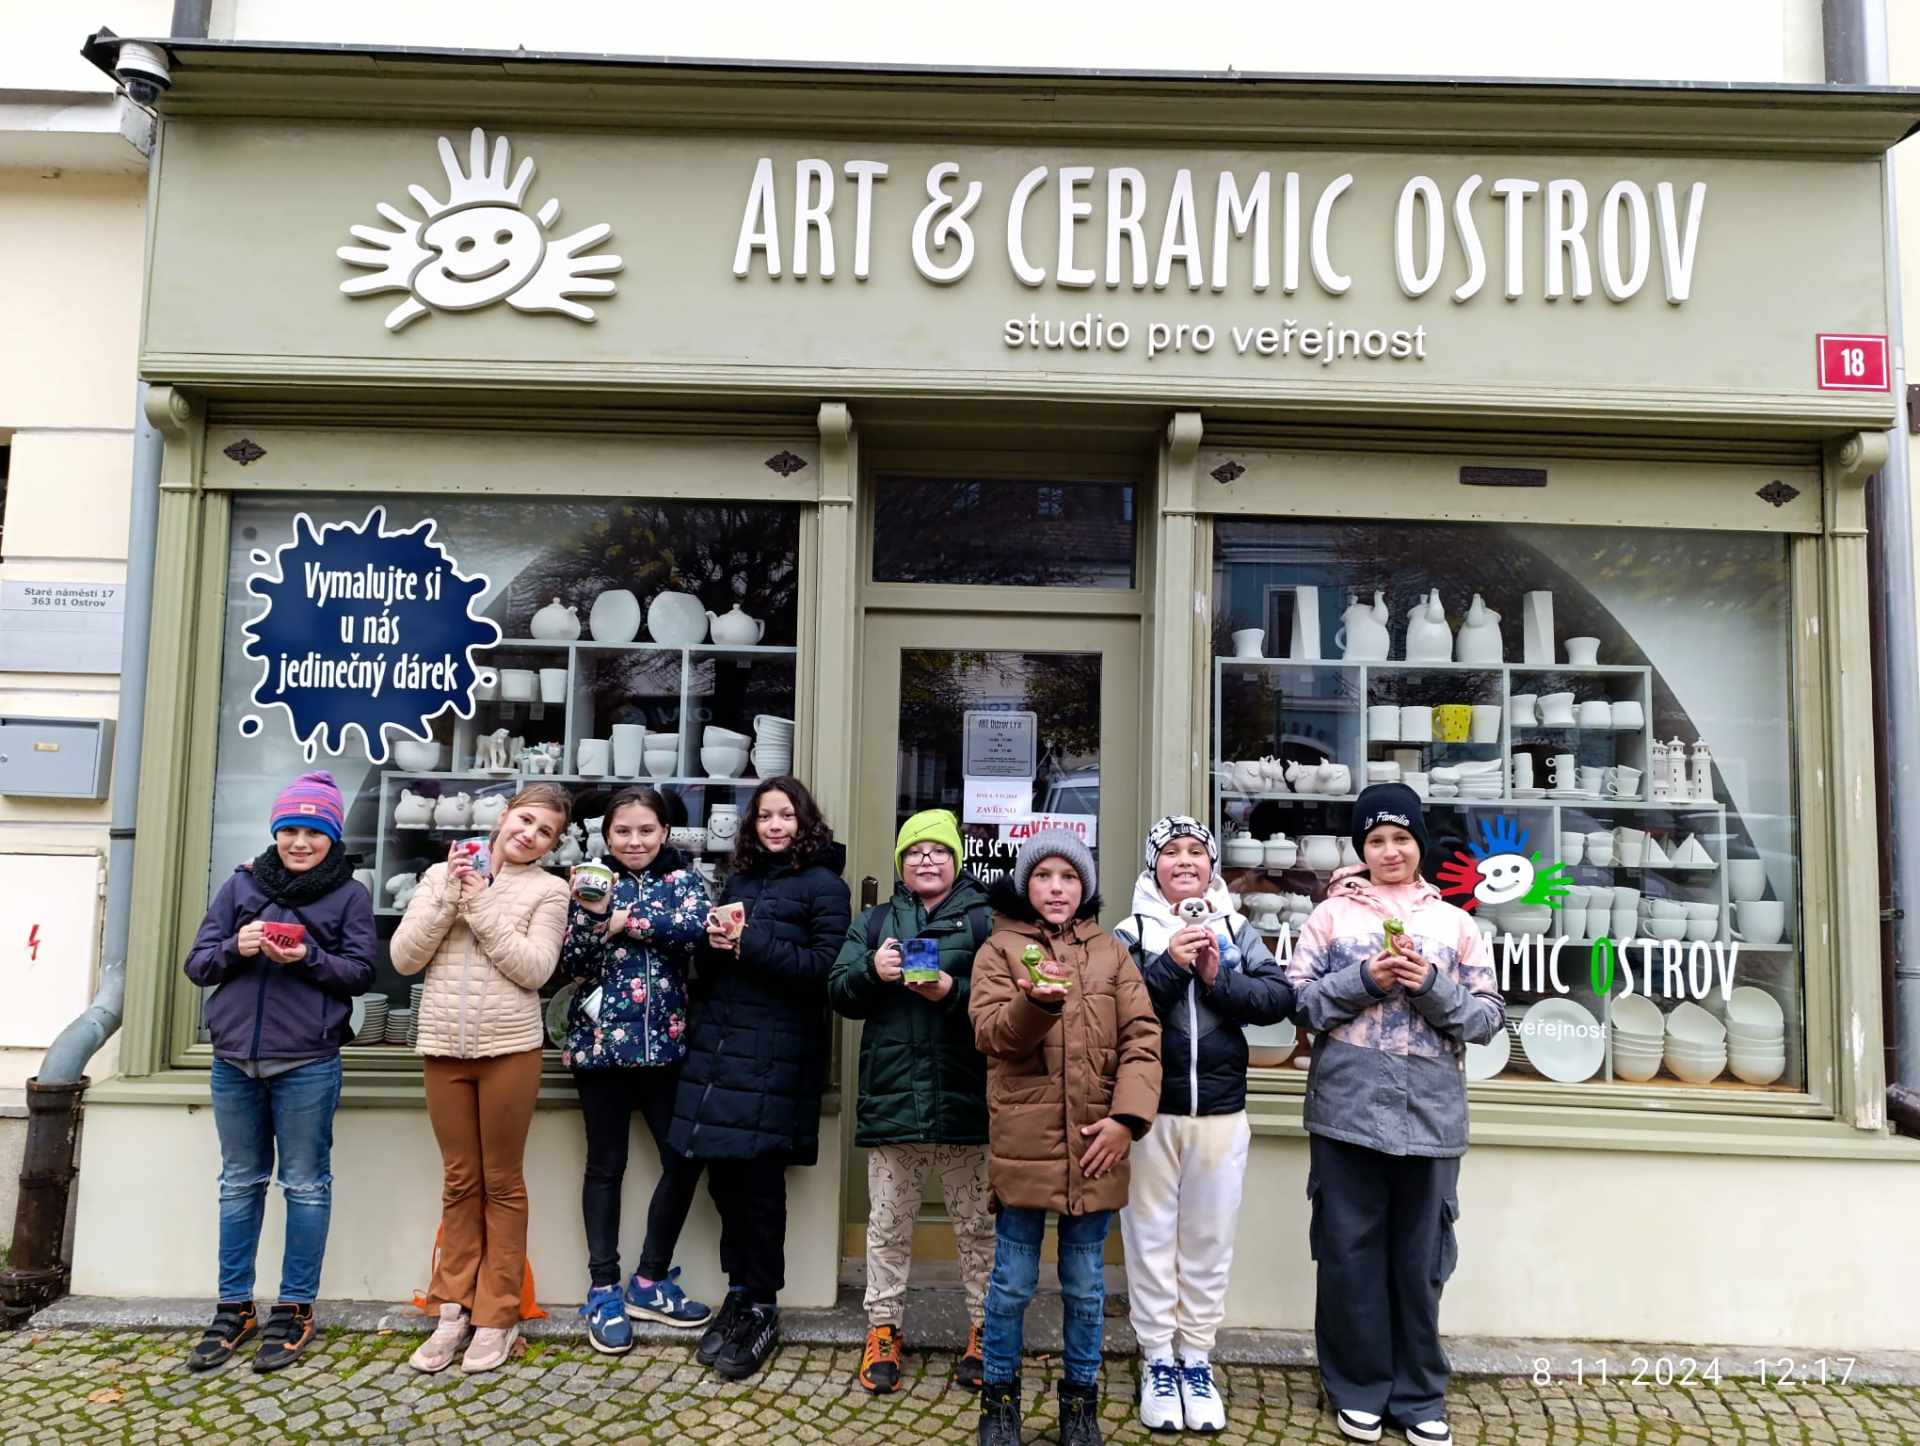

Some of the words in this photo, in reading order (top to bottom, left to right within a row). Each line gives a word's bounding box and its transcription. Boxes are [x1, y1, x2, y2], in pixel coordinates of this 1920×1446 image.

[733, 158, 888, 280] ART
[912, 161, 983, 285] &
[1007, 165, 1354, 296] CERAMIC
[1394, 174, 1707, 306] OSTROV
[1004, 313, 1130, 350] studio
[1148, 321, 1215, 359] pro
[1232, 320, 1427, 366] veřejnost
[1841, 348, 1865, 377] 18
[24, 588, 52, 596] Staré
[102, 590, 114, 598] 17
[32, 597, 50, 606] 363
[55, 598, 66, 606] 01
[71, 598, 106, 607] Ostrov
[304, 562, 417, 608] Vymalujte
[425, 566, 442, 601] si
[341, 616, 354, 643] u
[363, 608, 400, 645] nás
[276, 652, 387, 698] jedinečný
[393, 653, 458, 692] dárek
[989, 838, 1002, 858] se
[1483, 931, 1570, 994] AMIC
[1590, 936, 1739, 1001] OSTROV
[1512, 1019, 1607, 1042] veřejnost
